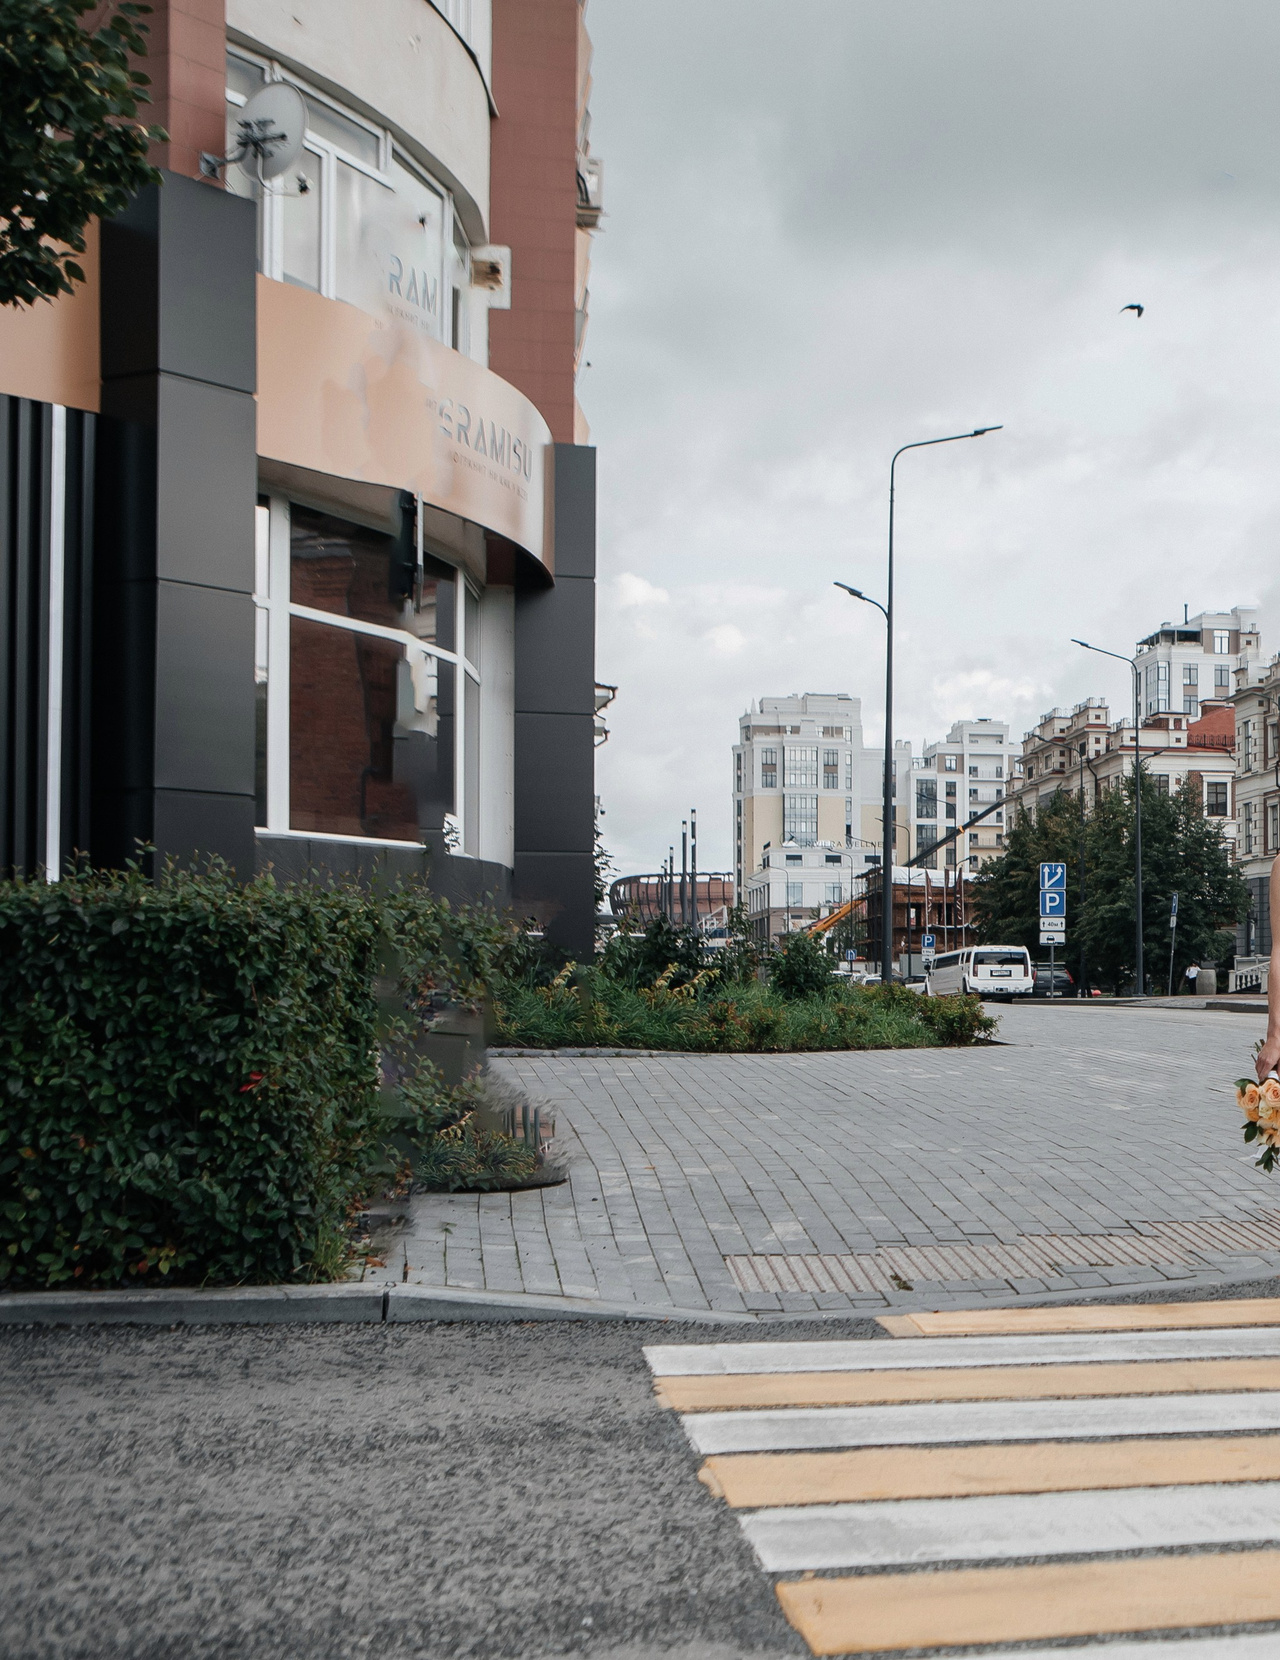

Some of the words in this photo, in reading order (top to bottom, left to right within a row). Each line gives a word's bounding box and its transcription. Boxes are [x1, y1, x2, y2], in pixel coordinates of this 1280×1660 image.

[845, 840, 883, 849] WELLNE
[1046, 893, 1060, 913] P
[924, 936, 933, 946] P
